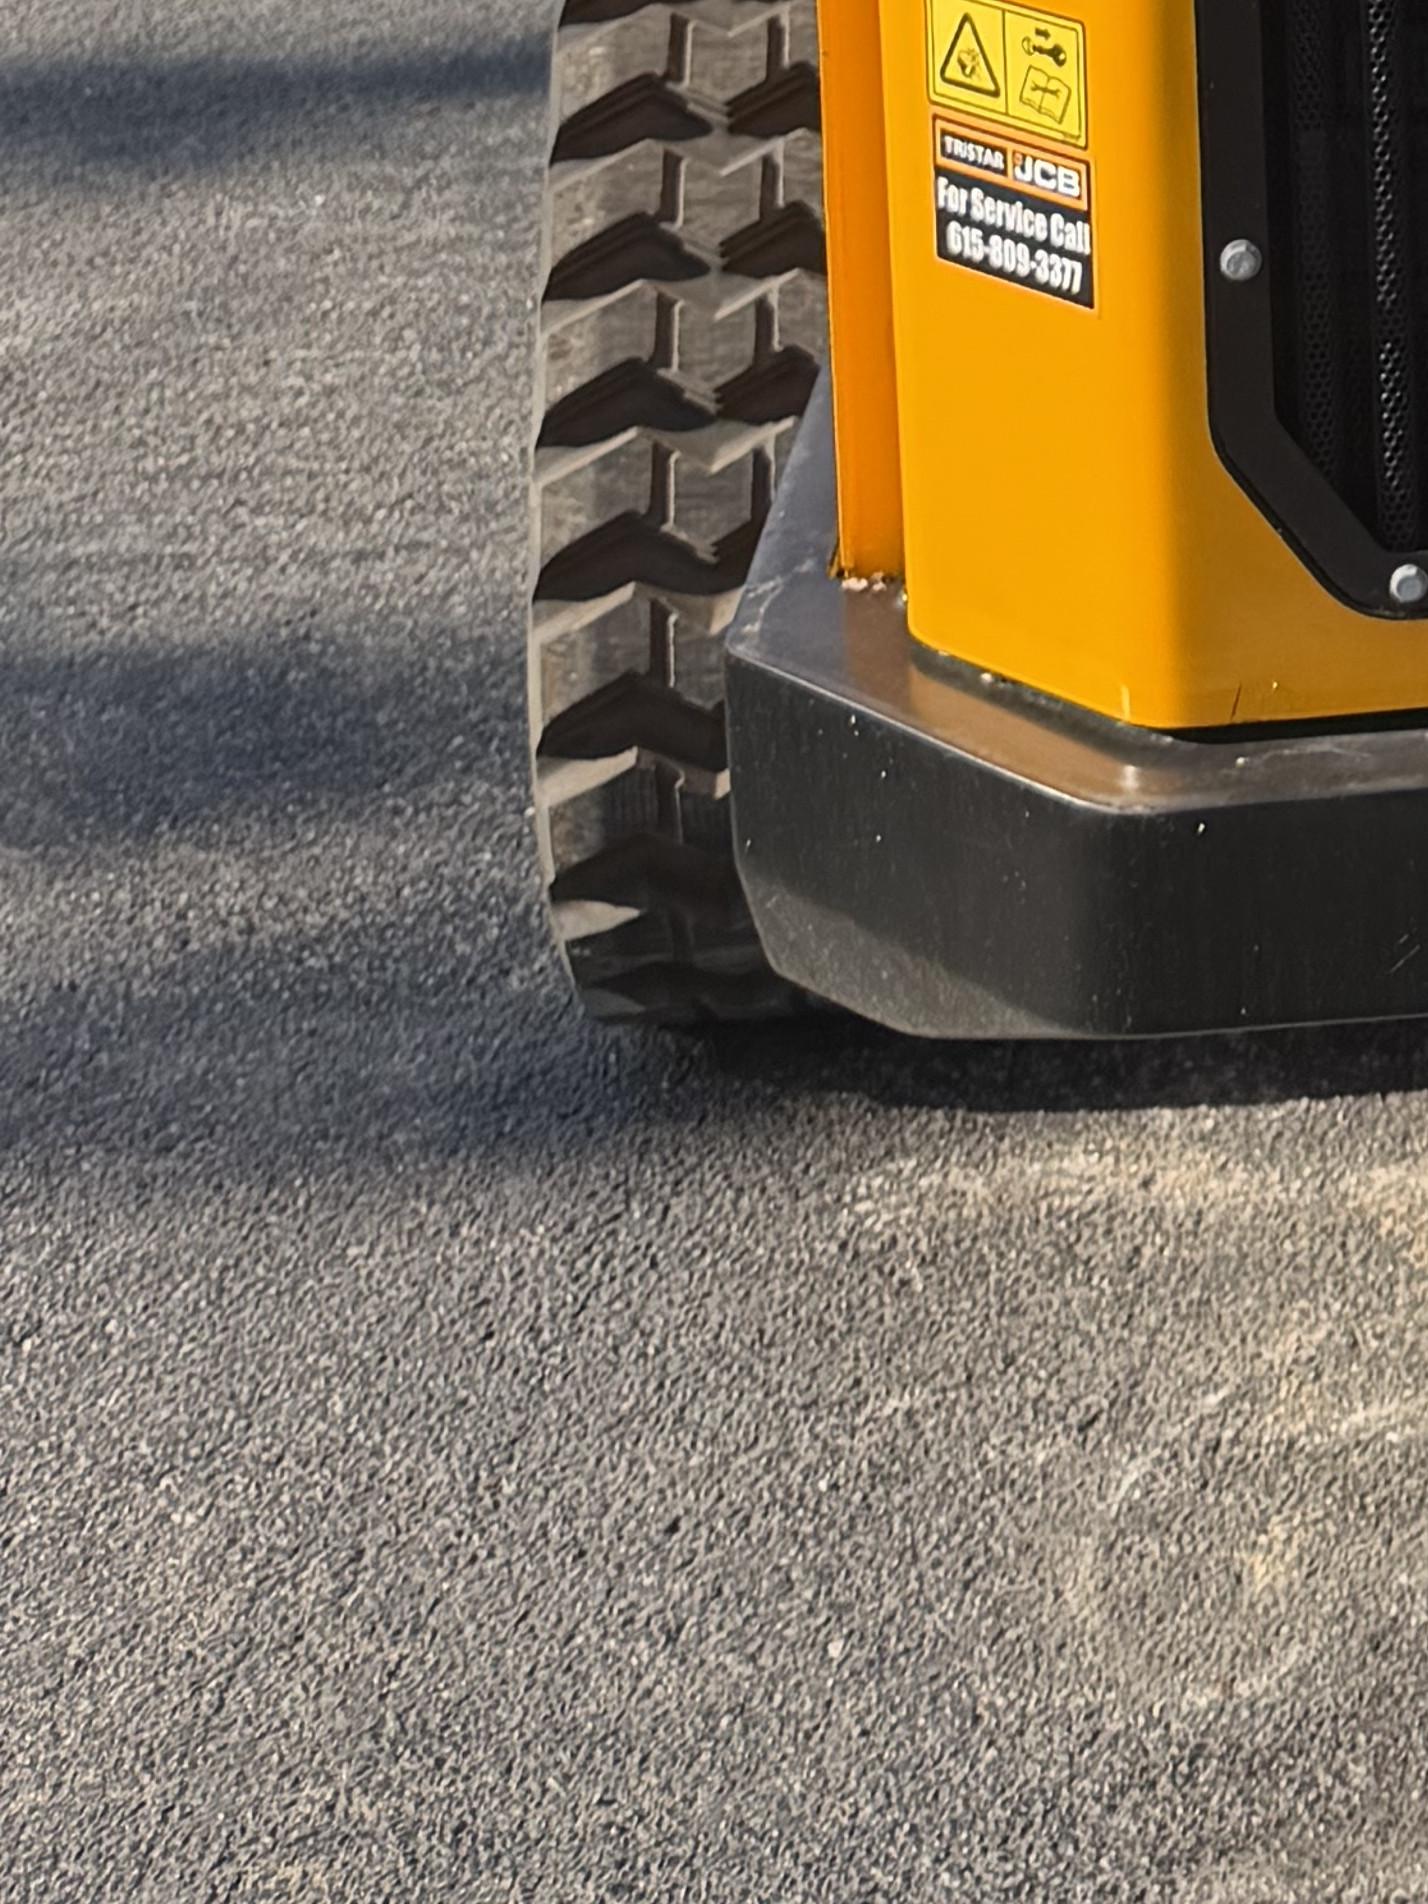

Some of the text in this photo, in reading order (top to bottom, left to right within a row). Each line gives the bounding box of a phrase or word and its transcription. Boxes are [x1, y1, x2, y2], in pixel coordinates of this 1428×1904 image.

[1014, 154, 1080, 197] JCB
[937, 176, 1091, 256] For Service Call
[946, 220, 1083, 295] 615-809-3377
